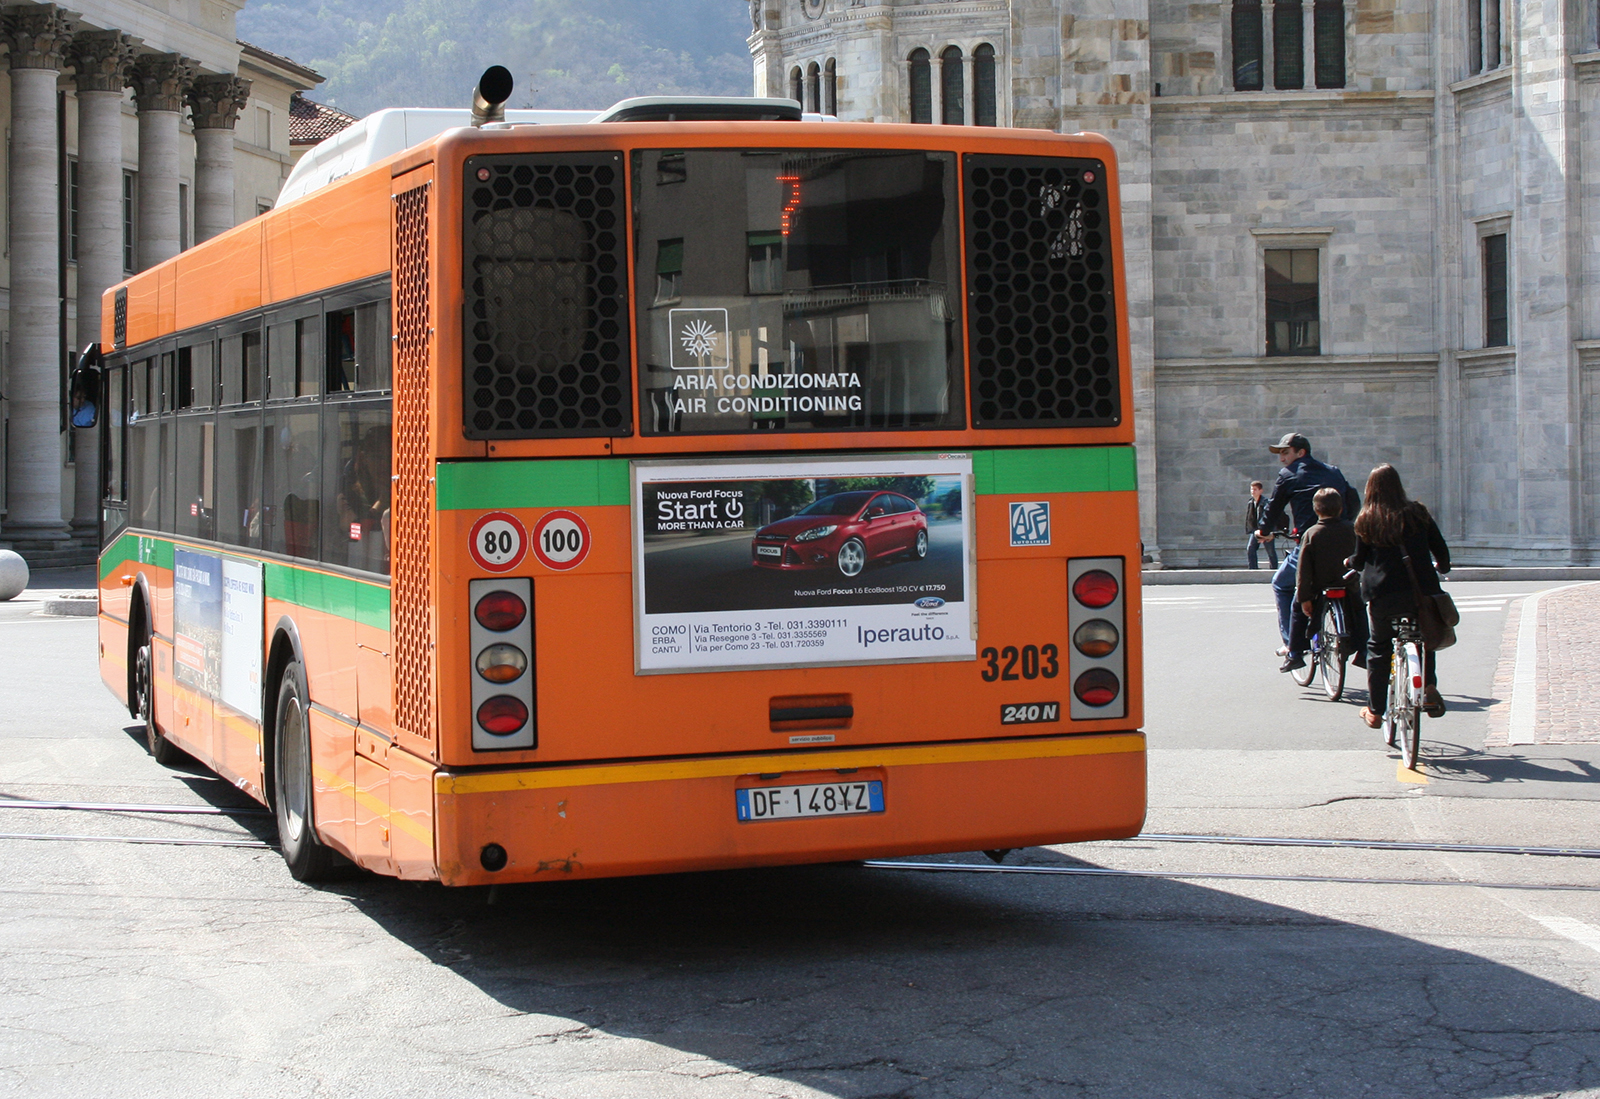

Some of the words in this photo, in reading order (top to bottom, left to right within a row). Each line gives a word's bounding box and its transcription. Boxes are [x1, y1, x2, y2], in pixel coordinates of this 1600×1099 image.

[776, 176, 800, 235] 7
[673, 374, 718, 390] ARIA
[722, 372, 861, 390] CONDIZIONATA
[674, 397, 707, 413] AIR
[717, 395, 862, 413] CONDITIONING
[657, 491, 689, 500] Nuova
[690, 490, 712, 499] Ford
[714, 489, 743, 498] Focus
[658, 500, 718, 520] Start
[657, 522, 686, 531] MORE
[687, 521, 714, 530] THAN
[724, 520, 744, 528] CAR
[484, 530, 512, 554] 80
[543, 529, 580, 552] 100
[652, 625, 686, 635] COMO
[693, 624, 709, 633] Via
[712, 622, 752, 633] Tentorio
[754, 622, 761, 631] 3
[787, 619, 847, 630] 031.3390111
[652, 636, 676, 645] ERBA
[694, 635, 708, 643] Via
[709, 633, 750, 643] Resegone
[857, 623, 945, 648] Iperauto
[709, 645, 723, 653] per
[750, 642, 760, 650] 23
[780, 639, 825, 648] 031.720359
[981, 643, 1059, 683] 3203
[1003, 705, 1040, 722] 240
[1042, 704, 1057, 720] N
